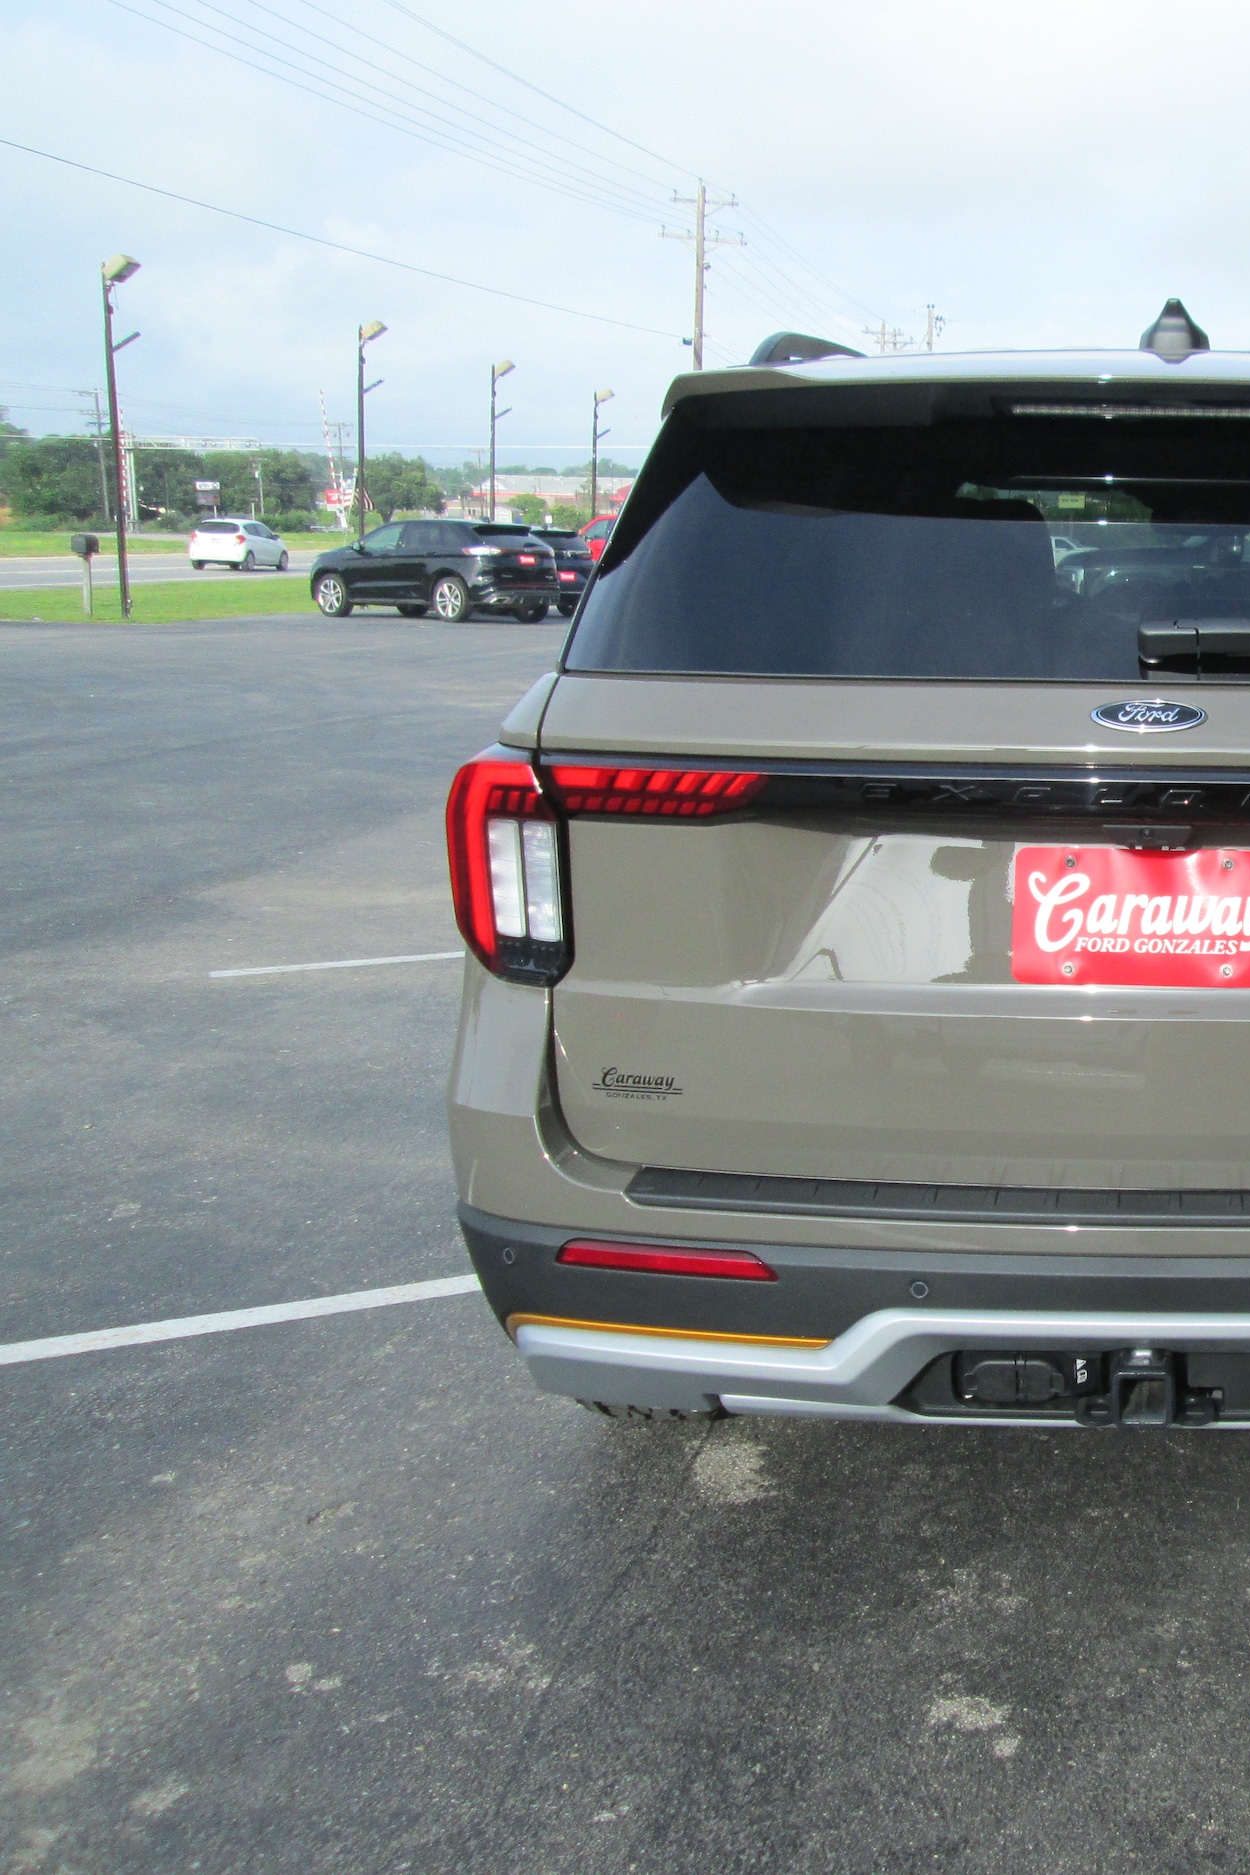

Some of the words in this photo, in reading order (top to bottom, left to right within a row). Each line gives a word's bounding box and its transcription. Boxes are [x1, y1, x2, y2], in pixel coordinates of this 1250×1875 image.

[1118, 702, 1180, 722] Ford
[1074, 936, 1130, 953] FORD
[1133, 938, 1239, 955] GONZALES
[601, 1067, 674, 1090] Caraway
